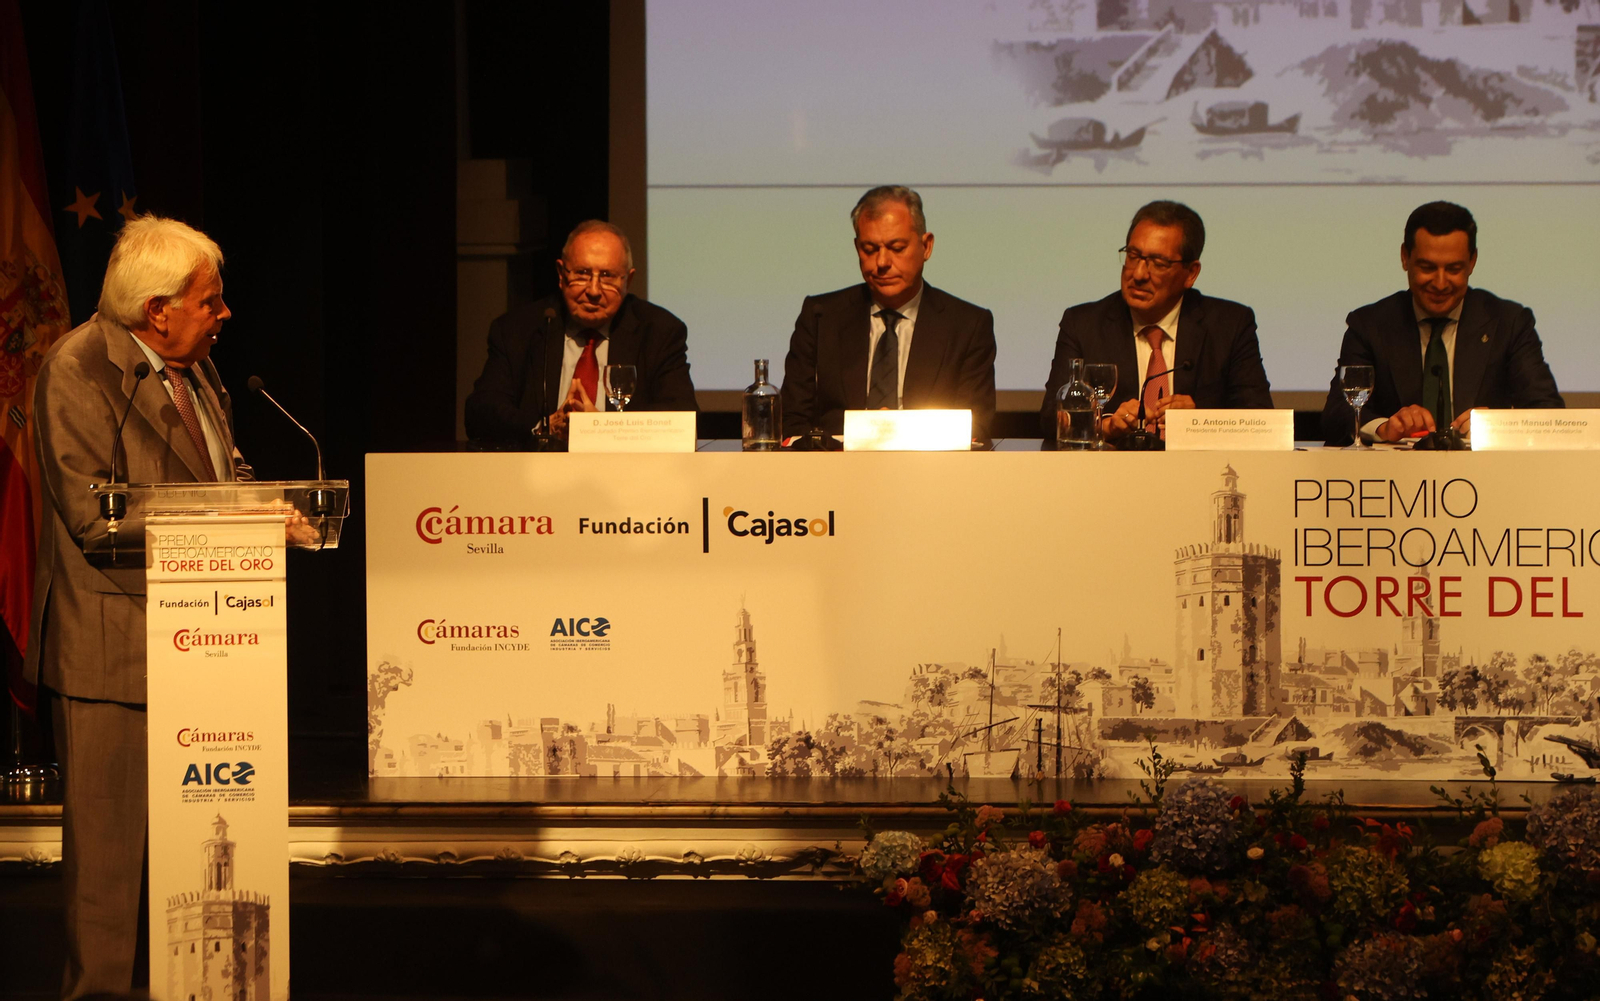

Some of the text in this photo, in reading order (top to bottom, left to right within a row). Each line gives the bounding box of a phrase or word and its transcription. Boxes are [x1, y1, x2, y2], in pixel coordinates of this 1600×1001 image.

[604, 419, 624, 427] José
[626, 419, 644, 427] Luis
[646, 419, 672, 427] Bonet
[1192, 418, 1267, 426] D. Antonio Pulido
[1499, 419, 1519, 427] Juan
[1521, 419, 1553, 427] Manuel
[1554, 419, 1588, 427] Moreno
[1294, 478, 1478, 519] PREMIO
[579, 507, 834, 544] Fundación Cajasol
[159, 534, 208, 546] PREMIO
[159, 545, 274, 559] IBEROAMERICANO
[467, 543, 504, 554] Sevilla
[159, 558, 274, 572] TORRE DEL ORO
[159, 595, 274, 611] Fundación Cajasol
[1295, 575, 1584, 618] TORRE DEL
[450, 643, 530, 652] Fundación INCYDE
